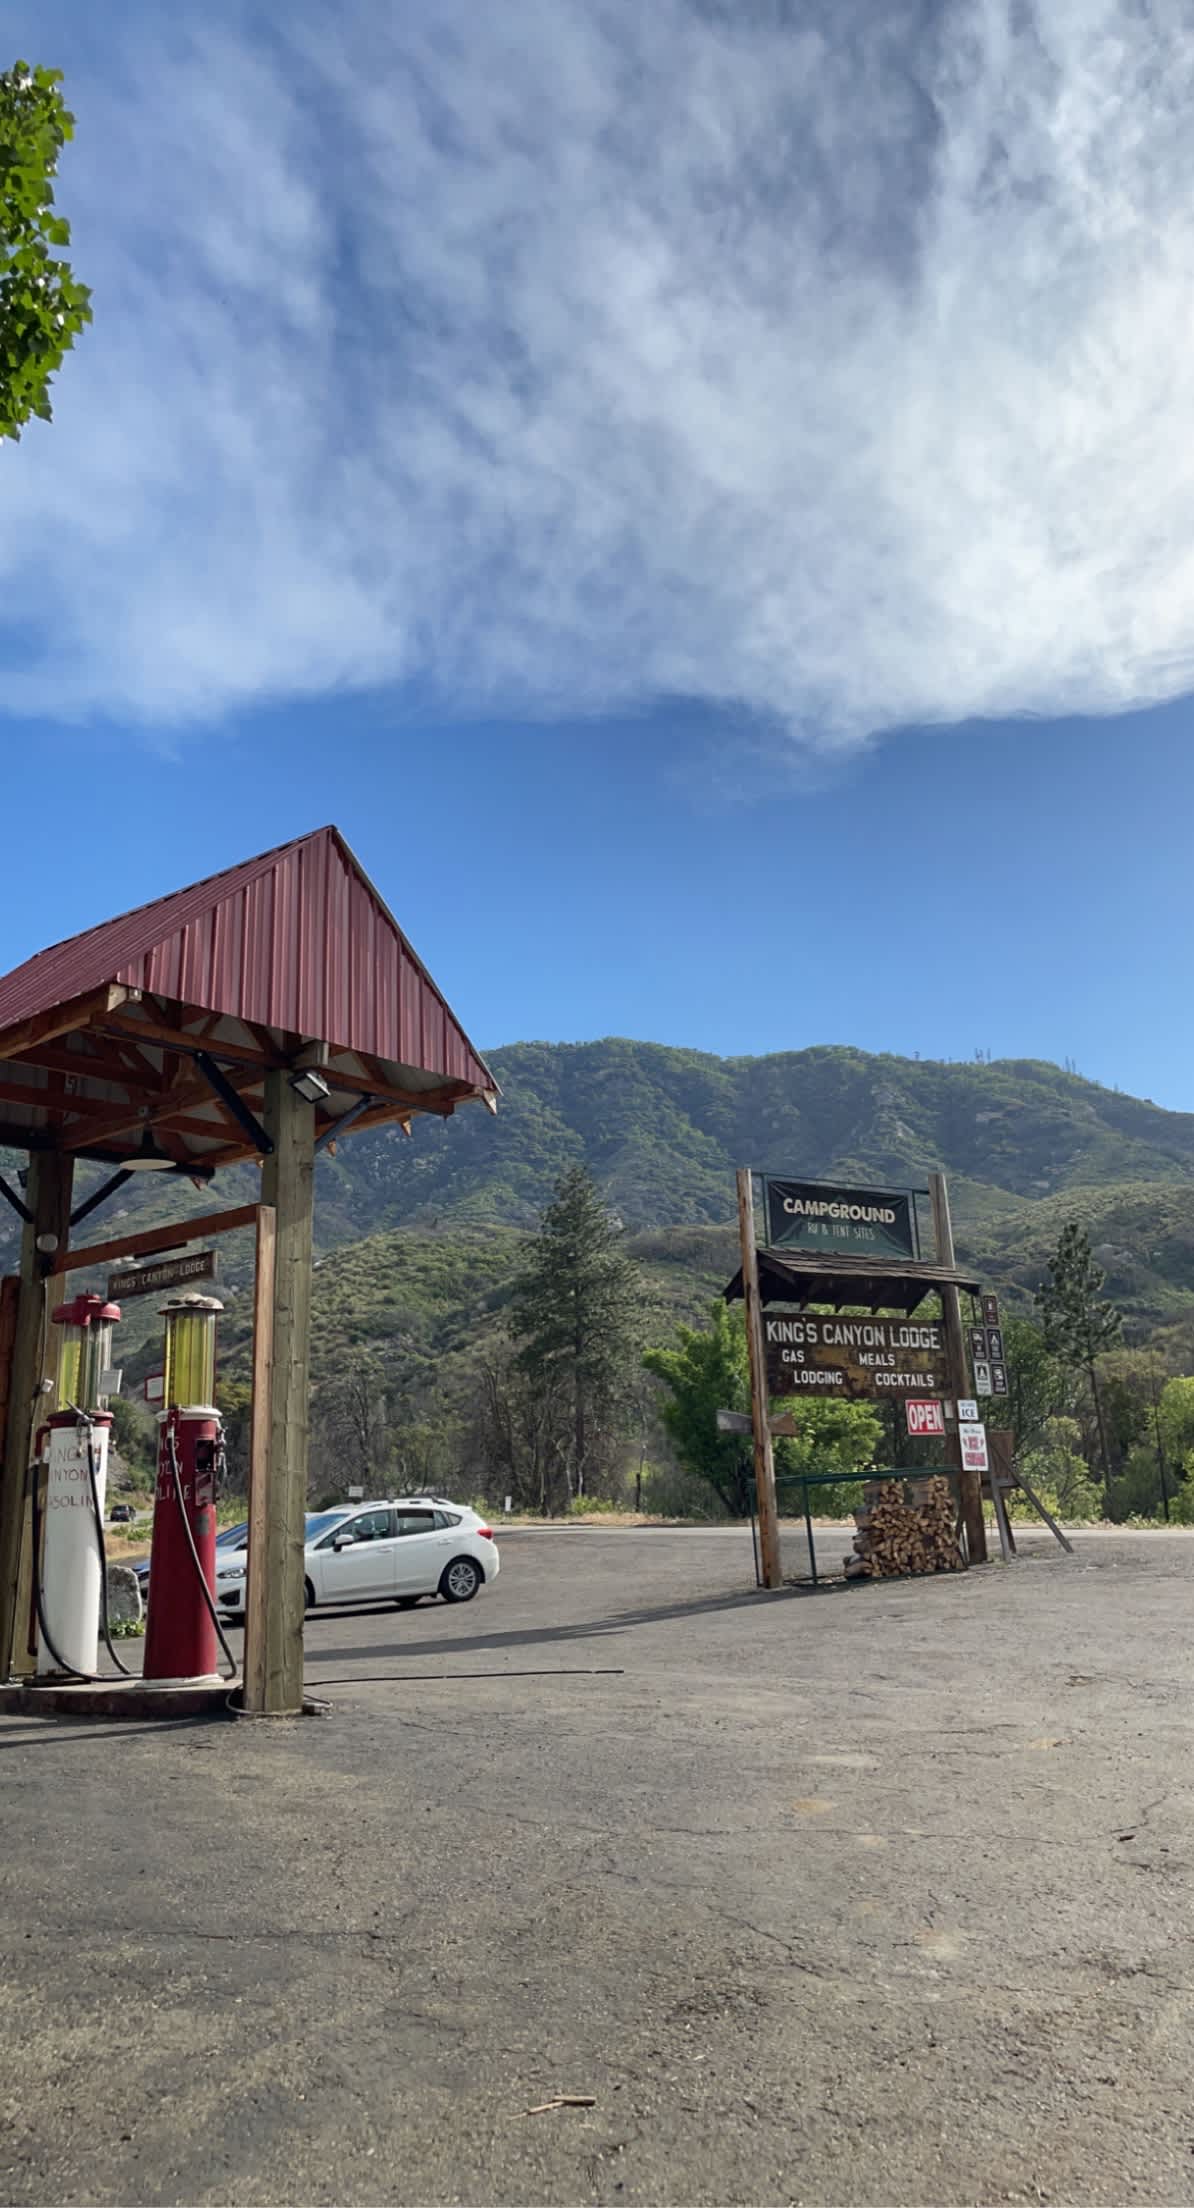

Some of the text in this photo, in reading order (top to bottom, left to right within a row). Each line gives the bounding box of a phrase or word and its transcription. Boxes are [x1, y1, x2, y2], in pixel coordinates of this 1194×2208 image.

[783, 1198, 896, 1223] CAMPGROUND
[832, 1224, 850, 1238] TENT
[853, 1227, 875, 1241] SITES
[180, 1260, 206, 1276] LODGE
[766, 1318, 941, 1349] KING'S CANYON LODGE
[782, 1350, 896, 1367] GAS MEALS
[793, 1371, 935, 1387] LODGING COCKTAILS
[908, 1404, 943, 1431] OPEN
[961, 1408, 976, 1418] ICE
